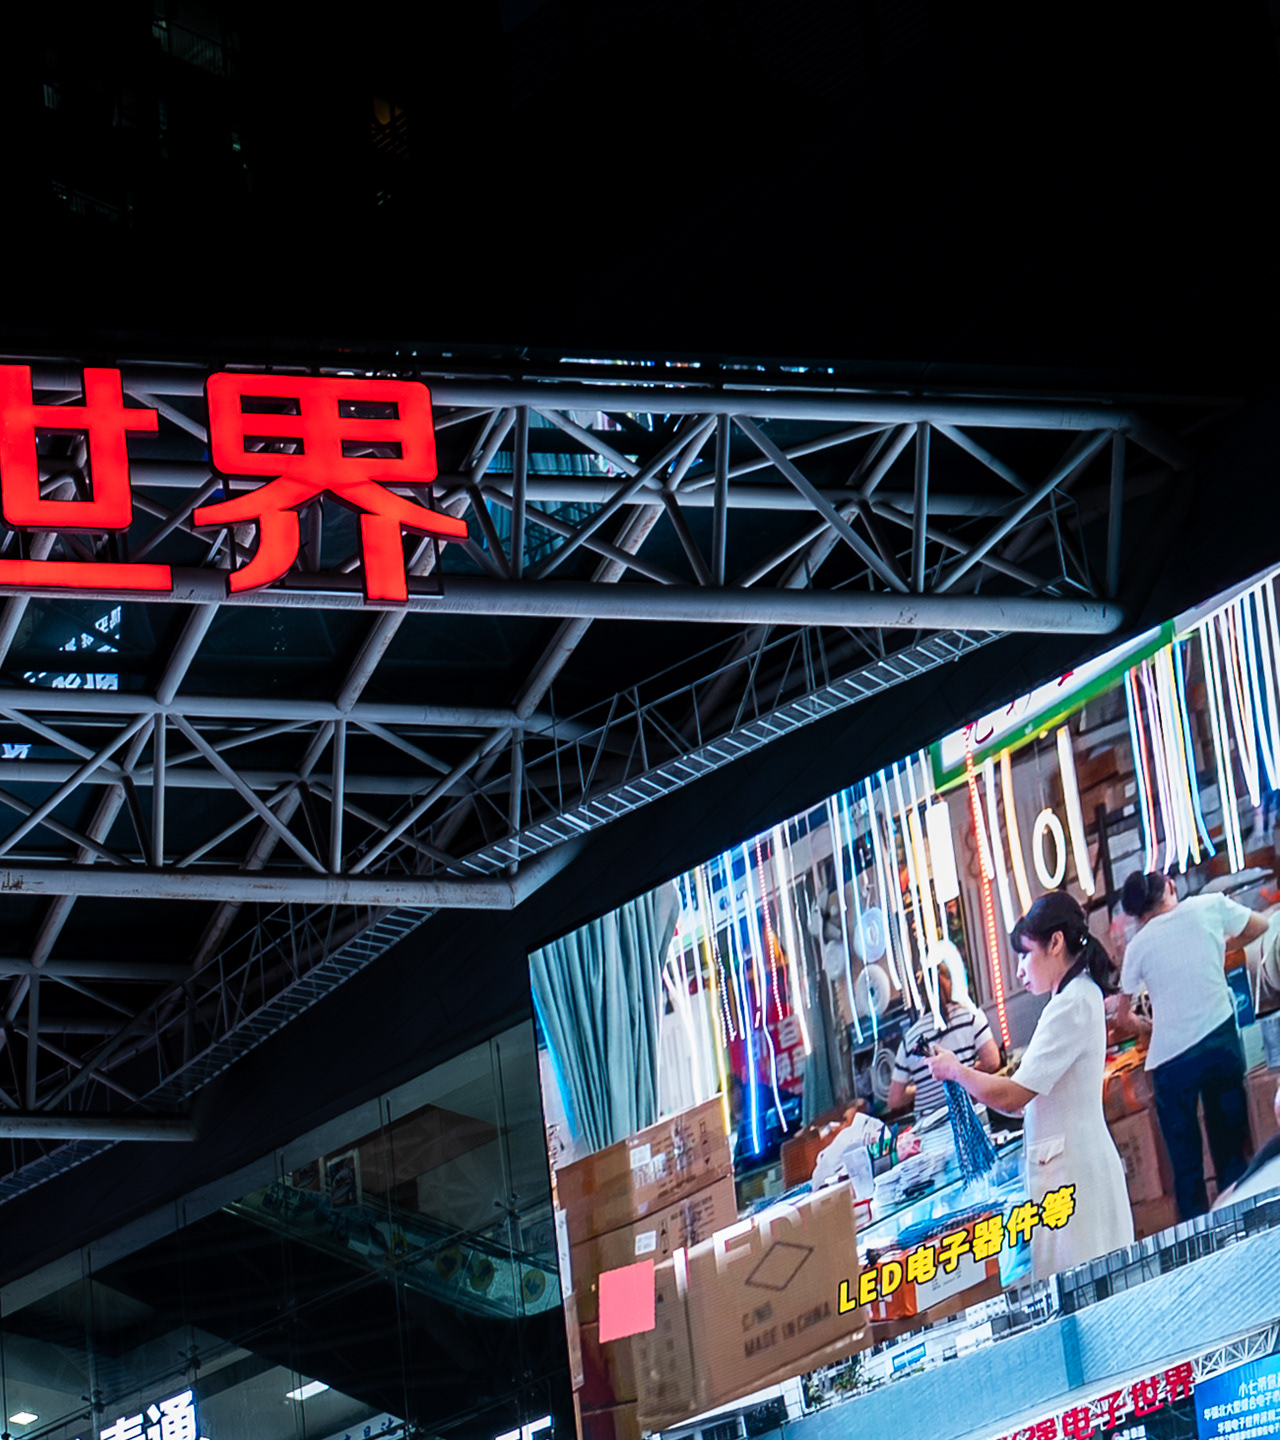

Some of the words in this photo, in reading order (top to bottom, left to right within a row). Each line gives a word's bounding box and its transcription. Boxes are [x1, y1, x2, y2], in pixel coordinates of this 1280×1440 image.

[837, 1182, 1078, 1315] LED电子器件等
